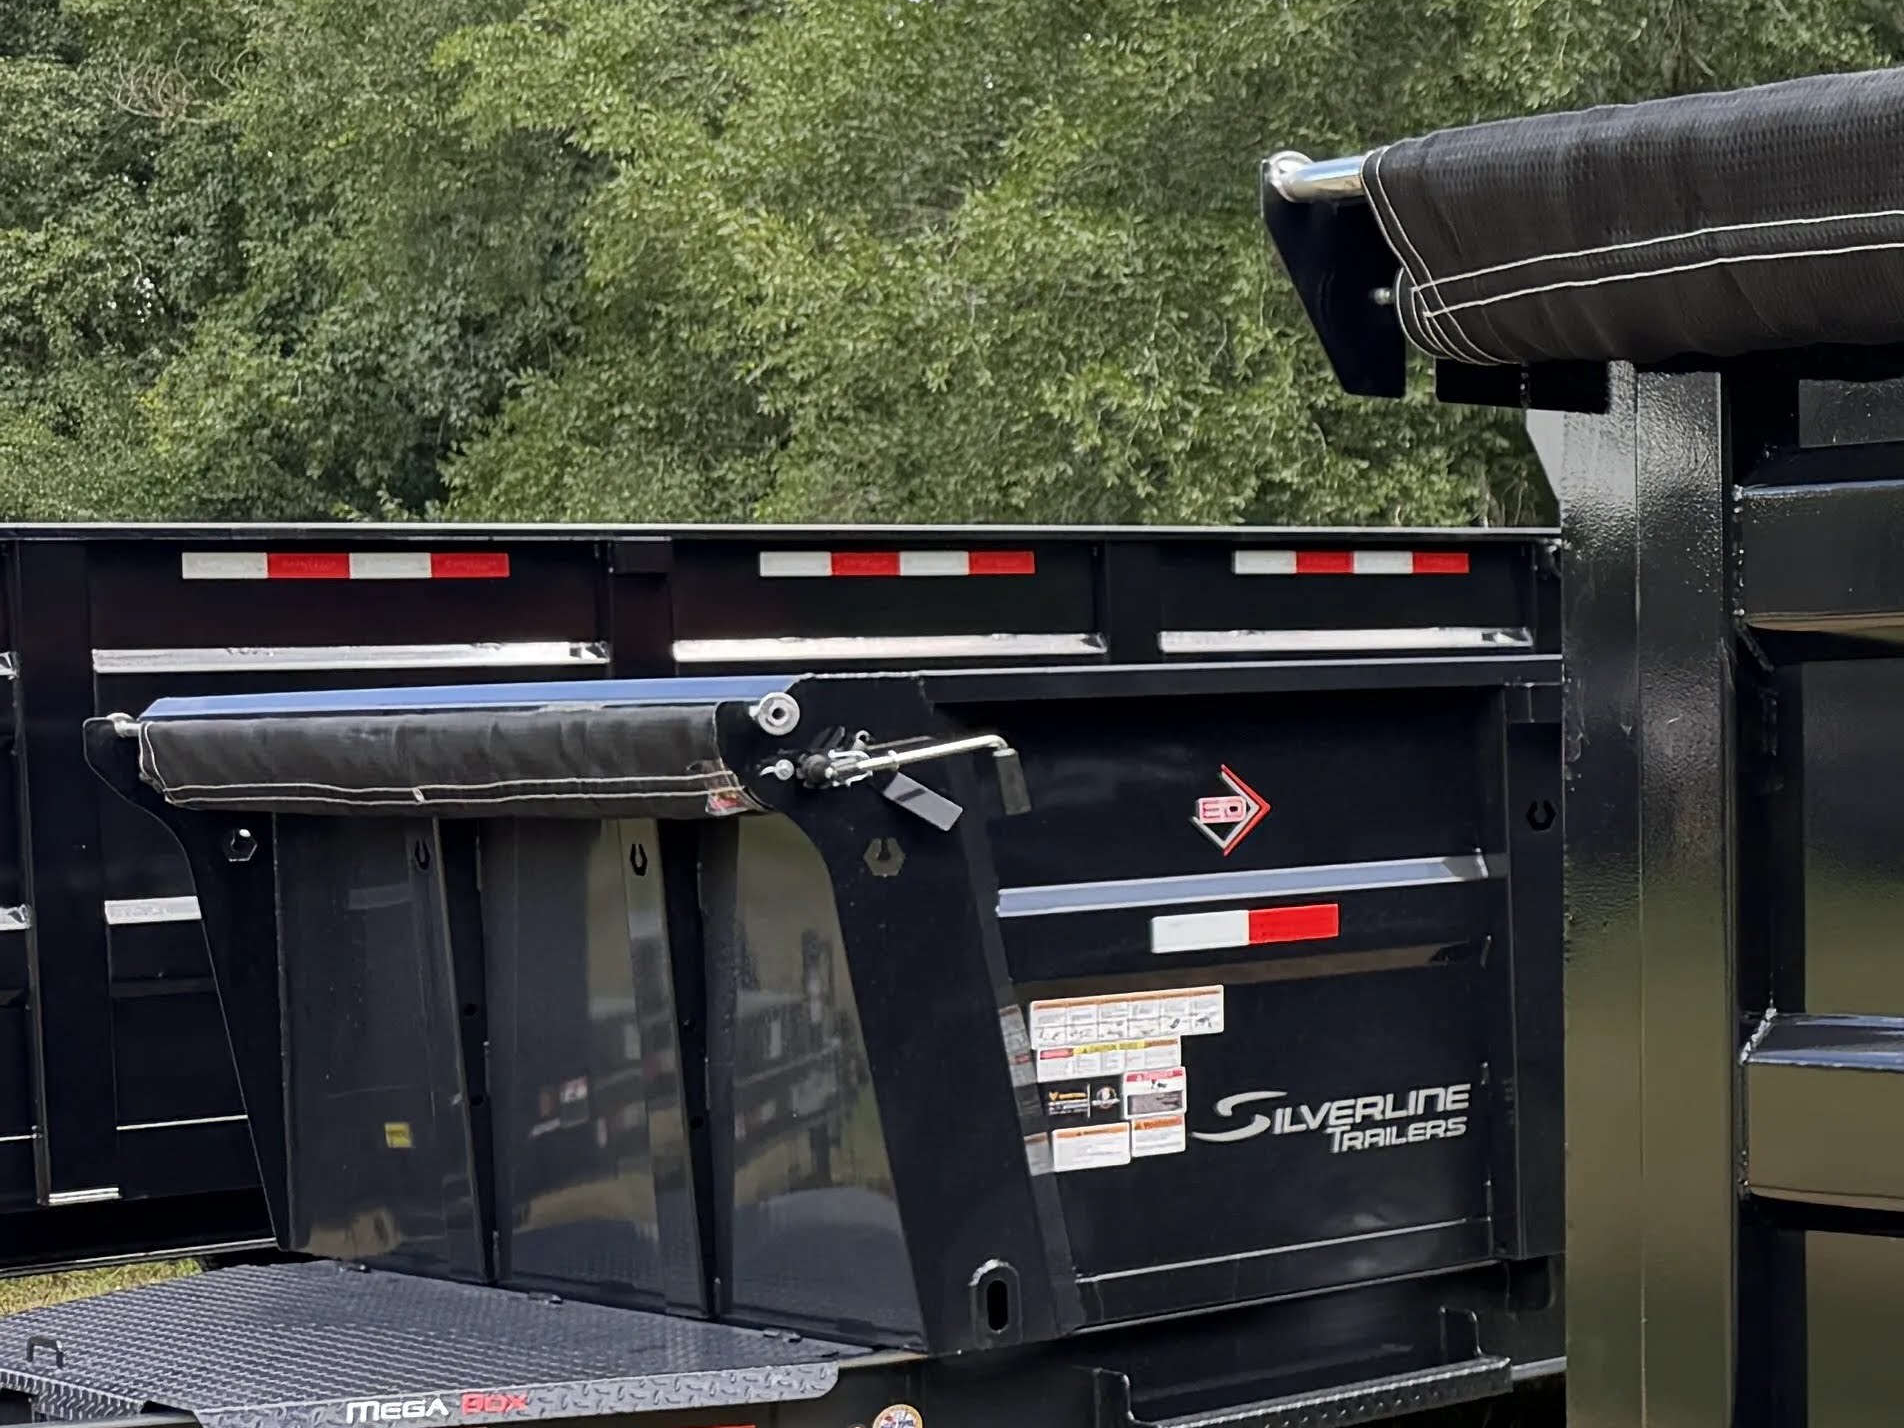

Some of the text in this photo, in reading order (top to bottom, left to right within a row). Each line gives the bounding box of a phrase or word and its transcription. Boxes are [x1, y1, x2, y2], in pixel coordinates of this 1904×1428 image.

[1191, 1083, 1471, 1142] SILVERLINE
[1323, 1117, 1468, 1154] TRAILERS
[346, 1392, 527, 1423] MEGA BOX
